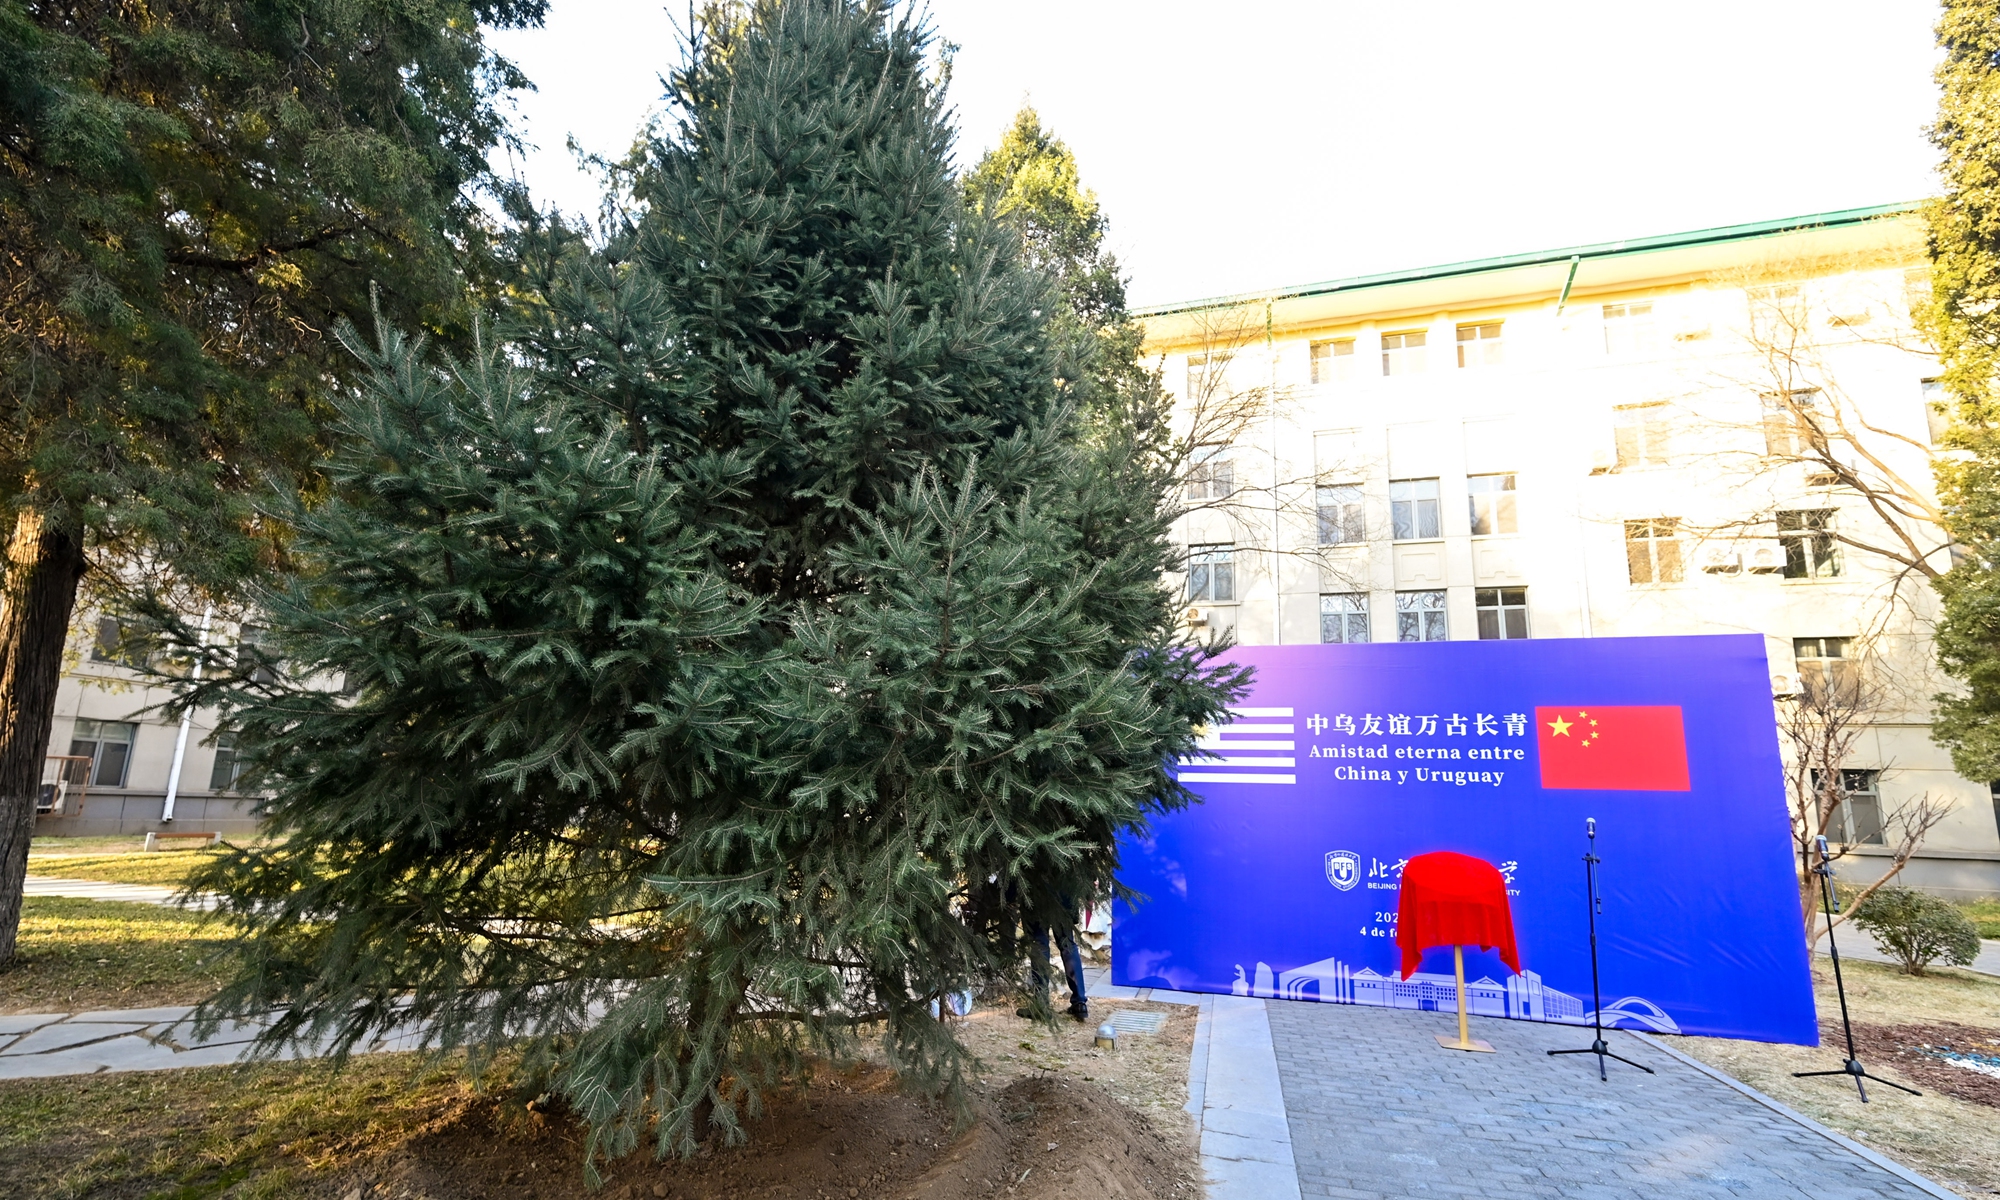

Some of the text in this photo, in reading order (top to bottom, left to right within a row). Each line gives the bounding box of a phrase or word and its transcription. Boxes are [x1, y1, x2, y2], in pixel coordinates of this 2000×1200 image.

[1306, 713, 1528, 737] 中乌友谊万古长青
[1308, 744, 1525, 760] Amistad eterna entre
[1334, 765, 1505, 787] China y Uruguay
[1367, 882, 1398, 890] BEIJING
[1359, 926, 1367, 936] 4
[1371, 927, 1385, 938] de
